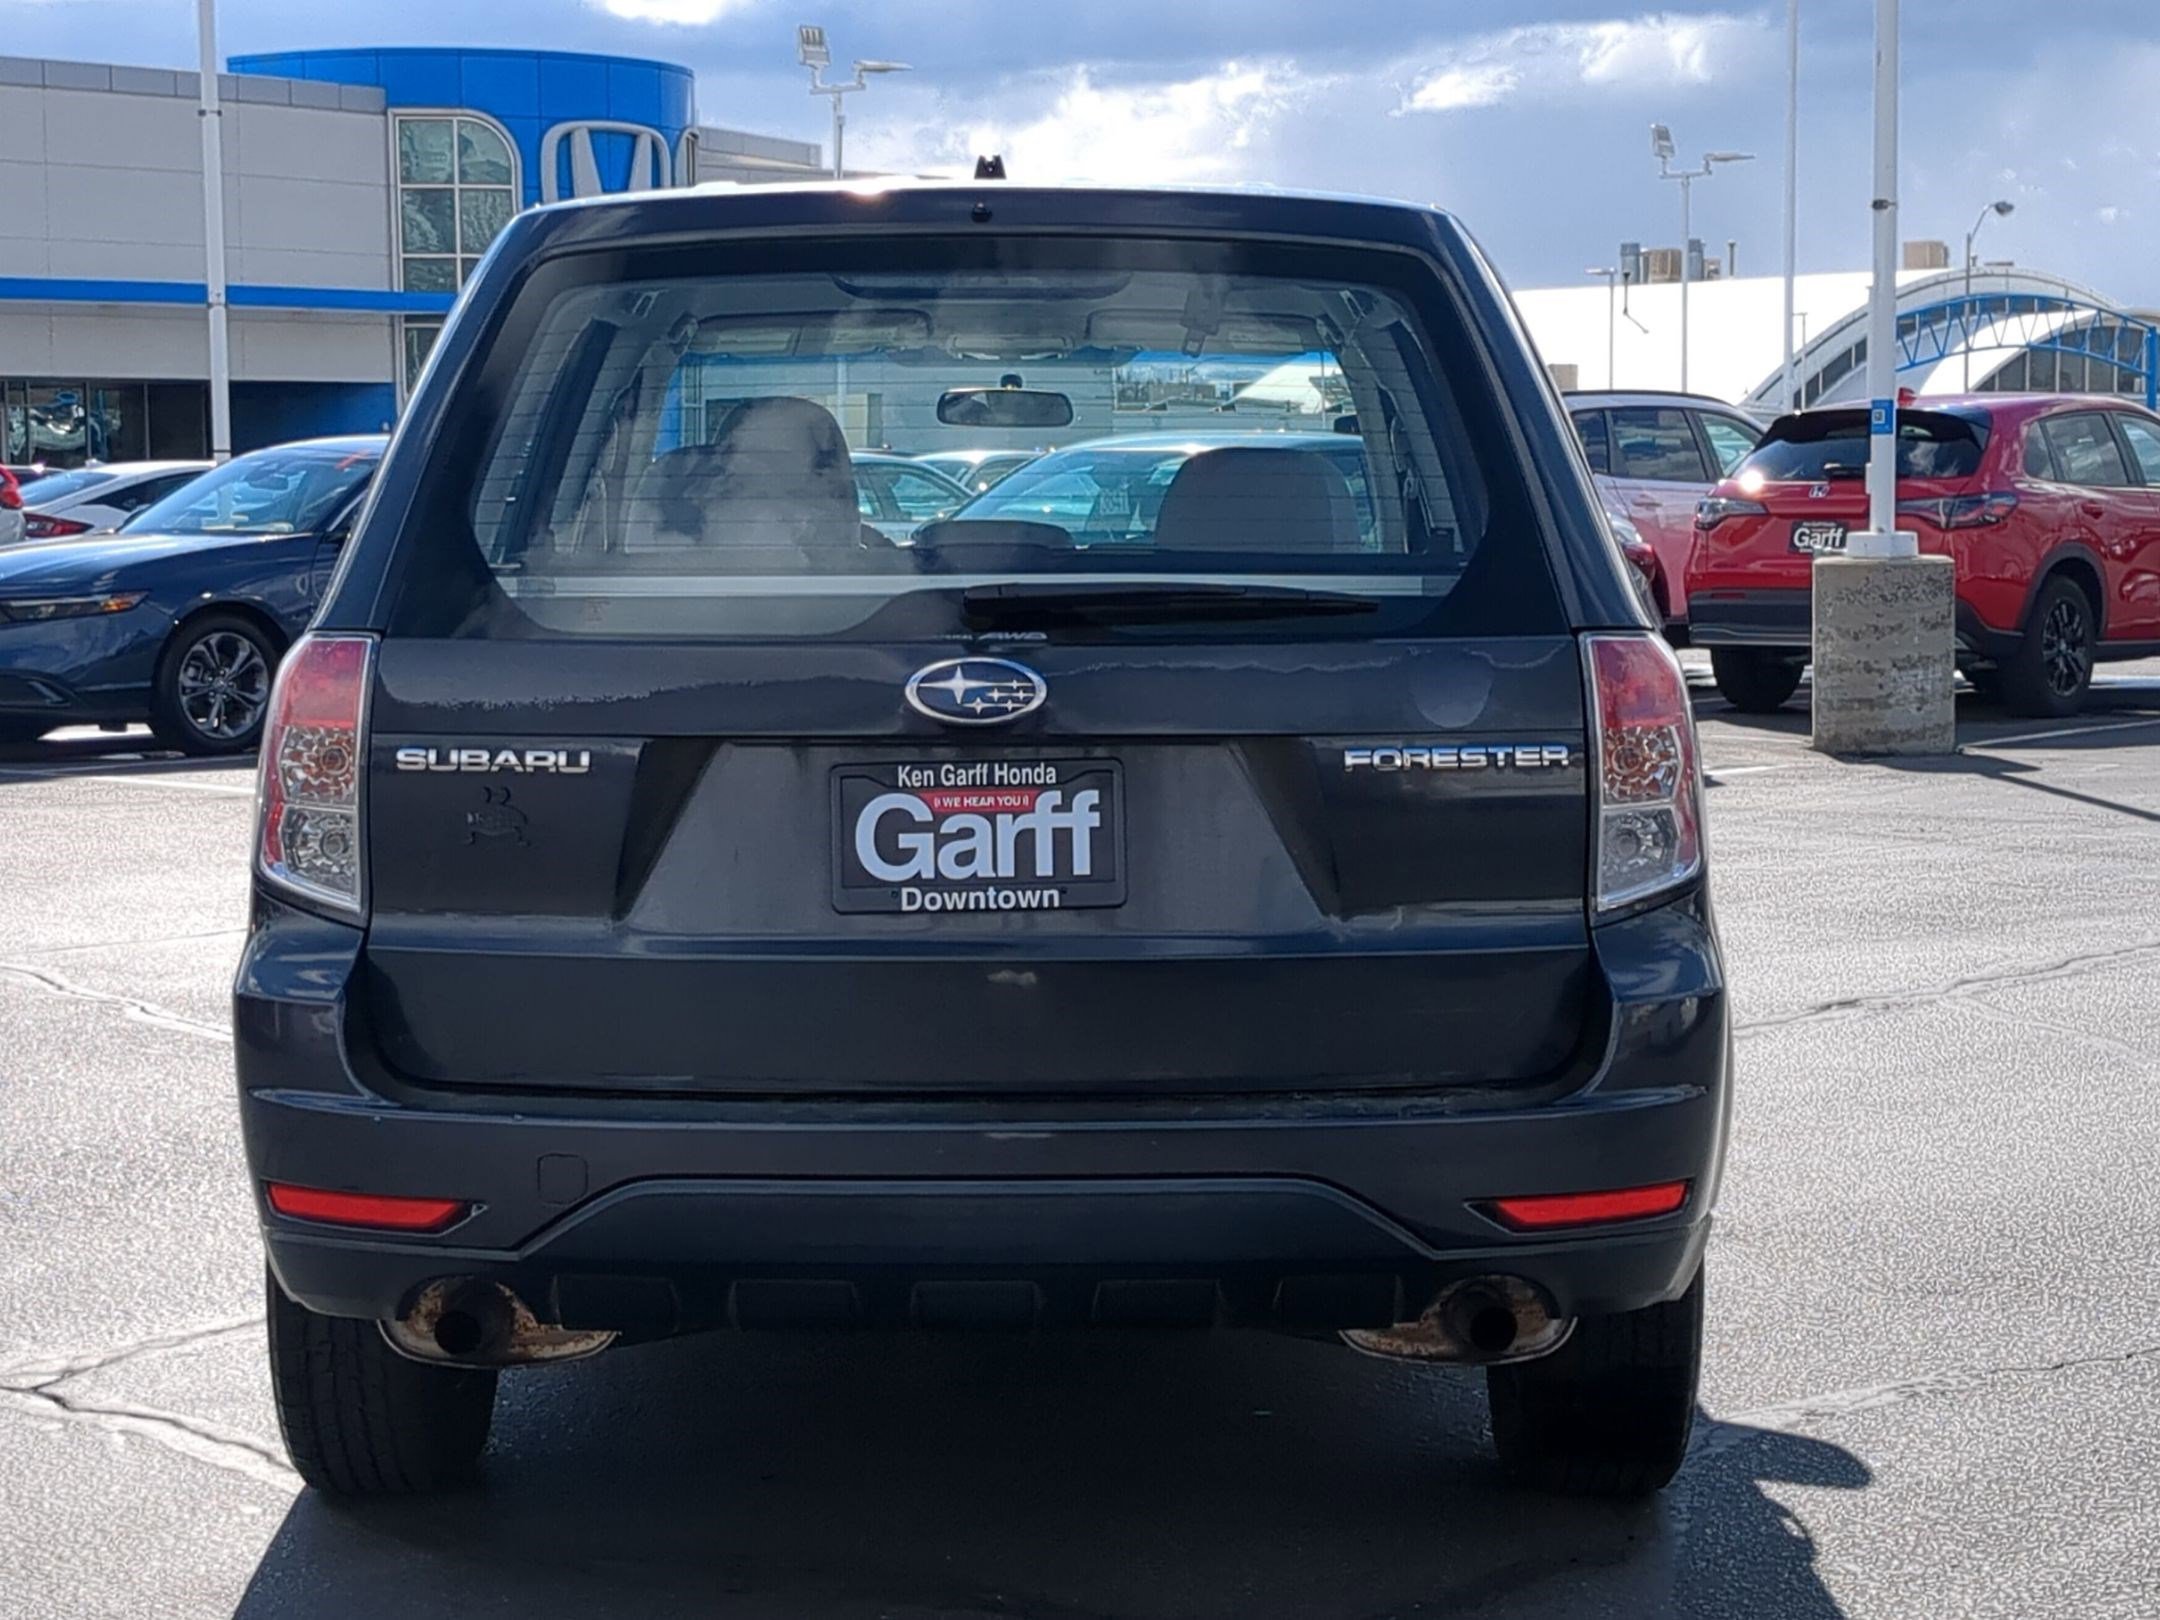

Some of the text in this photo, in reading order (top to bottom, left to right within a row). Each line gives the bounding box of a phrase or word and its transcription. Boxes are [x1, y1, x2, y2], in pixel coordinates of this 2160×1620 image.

[1793, 527, 1843, 548] Garff
[978, 631, 1048, 641] AWD
[396, 748, 591, 773] SUBARU
[1344, 746, 1569, 772] FORESTER
[898, 762, 1057, 787] Ken Garff Honda
[943, 795, 1021, 808] WE HEAR YOU
[855, 790, 1100, 882] Garff
[901, 886, 1060, 911] Downtown
